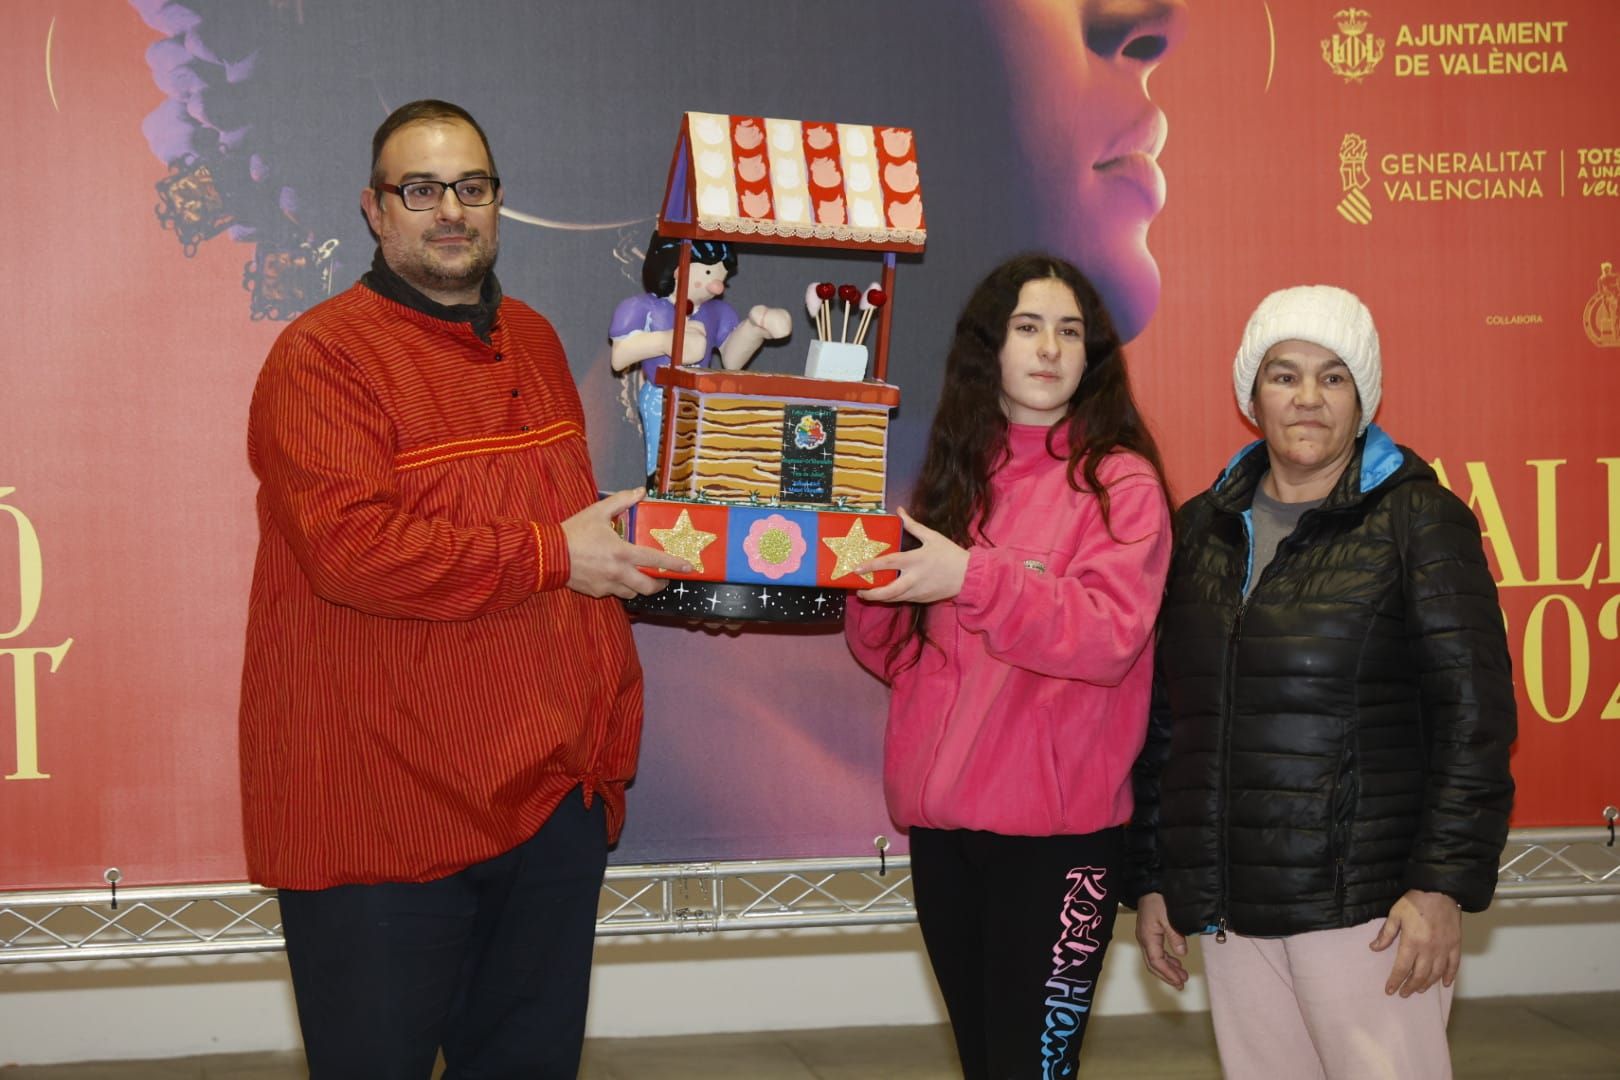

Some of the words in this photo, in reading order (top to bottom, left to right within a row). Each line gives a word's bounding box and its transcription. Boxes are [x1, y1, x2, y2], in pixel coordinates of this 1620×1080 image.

[1395, 22, 1569, 47] AJUNTAMENT
[1395, 54, 1430, 77] DE
[1439, 48, 1569, 76] VALÈNCIA
[1381, 150, 1548, 175] GENERALITAT
[1577, 166, 1588, 178] A
[1384, 178, 1544, 201] VALENCIANA
[1582, 180, 1619, 197] veu
[1053, 865, 1107, 976] Keith
